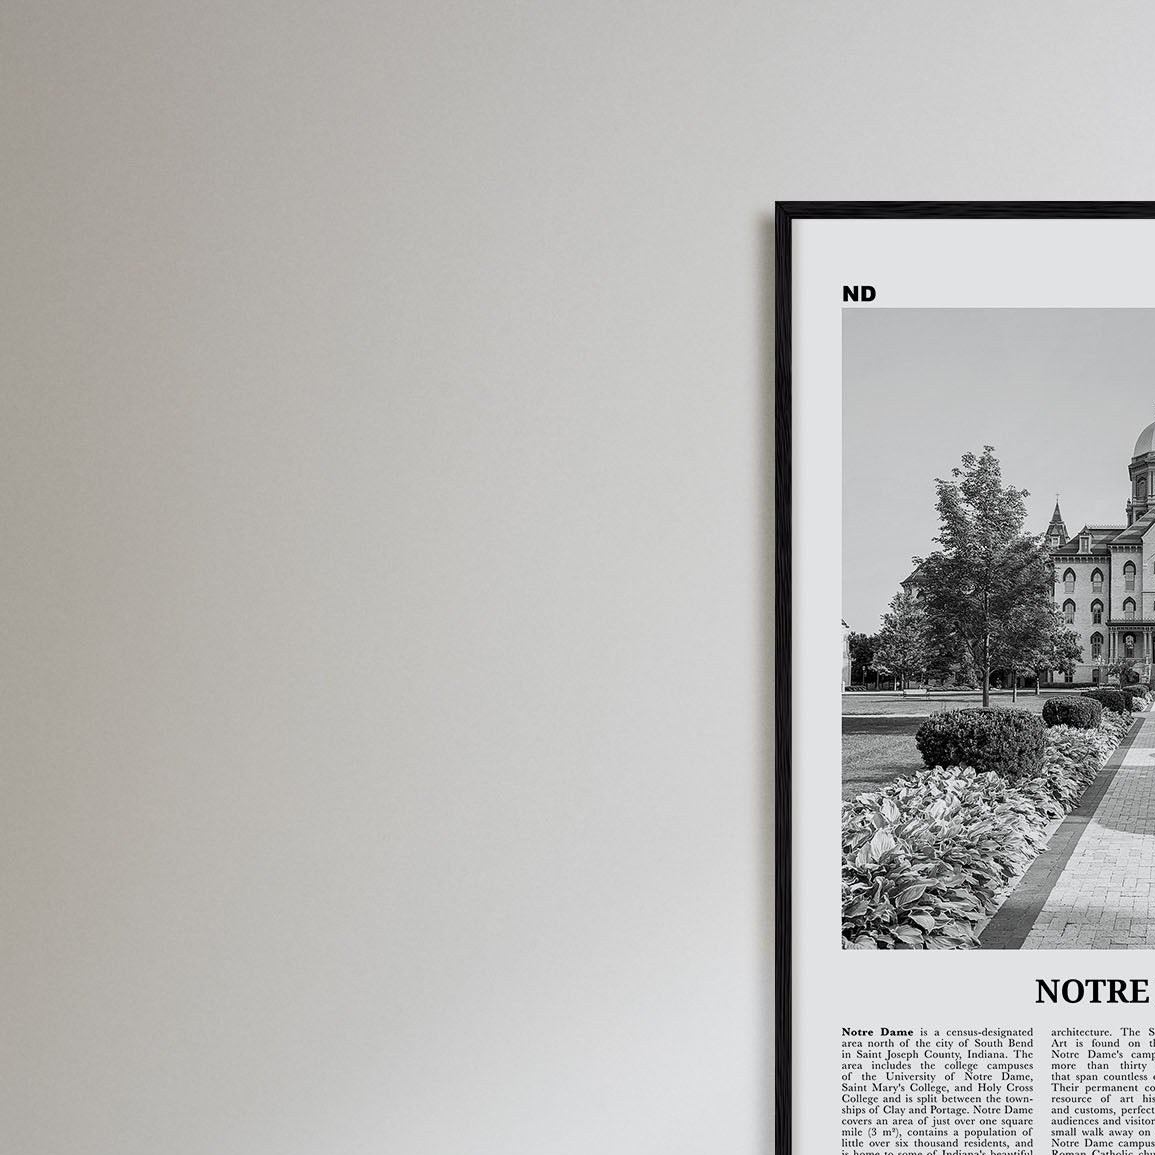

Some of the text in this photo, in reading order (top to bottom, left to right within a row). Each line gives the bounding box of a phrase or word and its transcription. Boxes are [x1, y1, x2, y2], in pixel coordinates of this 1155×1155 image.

[843, 286, 876, 302] ND
[1036, 979, 1149, 1003] NOTRE
[842, 1027, 873, 1036] Notre
[881, 1027, 913, 1036] Dame
[921, 1027, 927, 1036] is
[946, 1027, 1033, 1039] census-designated
[1051, 1027, 1112, 1036] architecture.
[1120, 1027, 1140, 1036] The
[1051, 1038, 1067, 1047] Art
[1076, 1038, 1083, 1047] is
[1092, 1038, 1119, 1047] found
[842, 1050, 1033, 1061] in Saint Joseph County, Indiana. The
[1051, 1050, 1079, 1059] Notre
[1088, 1050, 1123, 1059] Dame's
[872, 1061, 911, 1070] includes
[921, 1061, 935, 1070] the
[945, 1061, 978, 1072] college
[987, 1063, 1033, 1072] campuses
[1088, 1061, 1109, 1070] than
[1120, 1061, 1147, 1072] thirty
[1052, 1072, 1070, 1081] that
[1076, 1074, 1098, 1083] span
[1104, 1072, 1148, 1081] countless
[842, 1083, 1033, 1094] Saint Mary's College, and Holy Cross
[1051, 1083, 1079, 1092] Their
[1085, 1083, 1138, 1094] permanent
[842, 1094, 1033, 1105] College and is split between the town-
[1051, 1105, 1069, 1114] and
[1074, 1105, 1116, 1115] customs,
[1121, 1105, 1154, 1116] perfect
[918, 1116, 929, 1125] of
[933, 1116, 950, 1128] just
[1001, 1119, 1033, 1128] square
[1051, 1127, 1076, 1136] small
[1082, 1127, 1104, 1136] walk
[1109, 1130, 1133, 1139] away
[842, 1139, 863, 1147] little
[896, 1139, 908, 1147] six
[914, 1139, 958, 1147] thousand
[964, 1139, 1009, 1149] residents,
[1015, 1139, 1033, 1147] and
